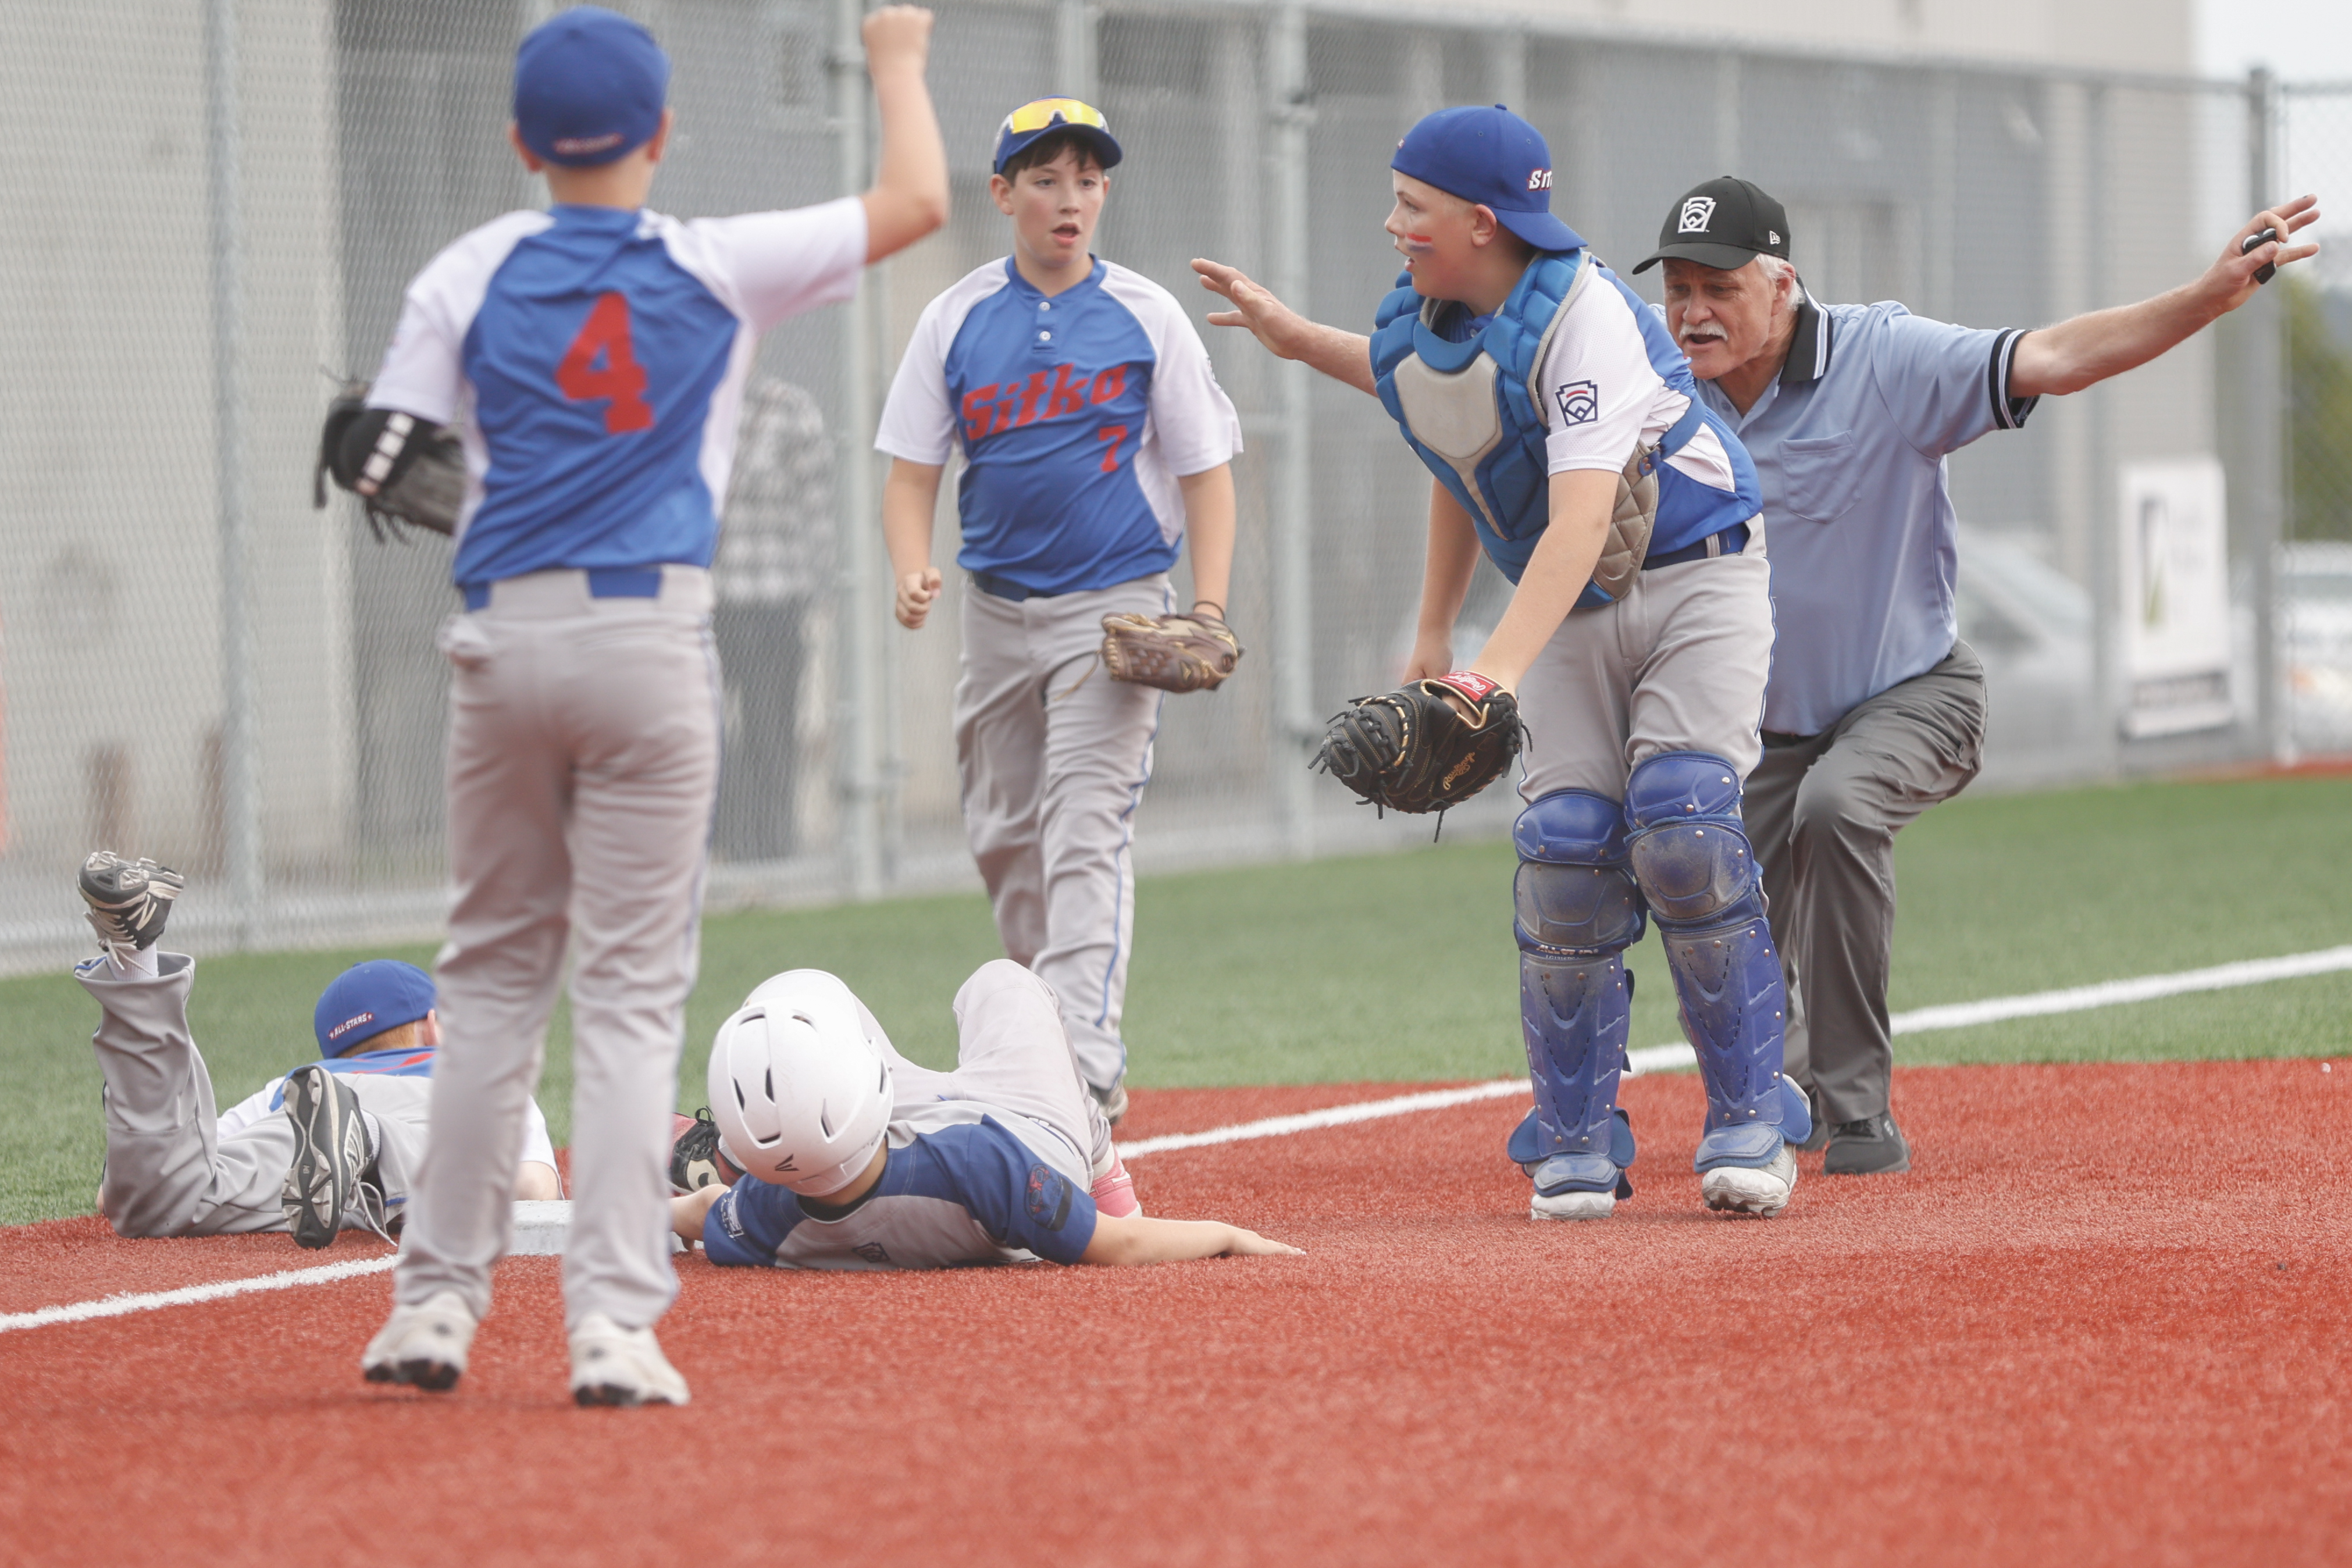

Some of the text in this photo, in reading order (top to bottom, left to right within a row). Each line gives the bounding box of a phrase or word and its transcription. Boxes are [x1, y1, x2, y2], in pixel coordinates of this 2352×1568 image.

[1527, 169, 1552, 190] SIT
[555, 291, 655, 435] 4
[963, 362, 1129, 441] Sitka
[1098, 425, 1128, 473] 7
[333, 1012, 368, 1038] ALL-STARS
